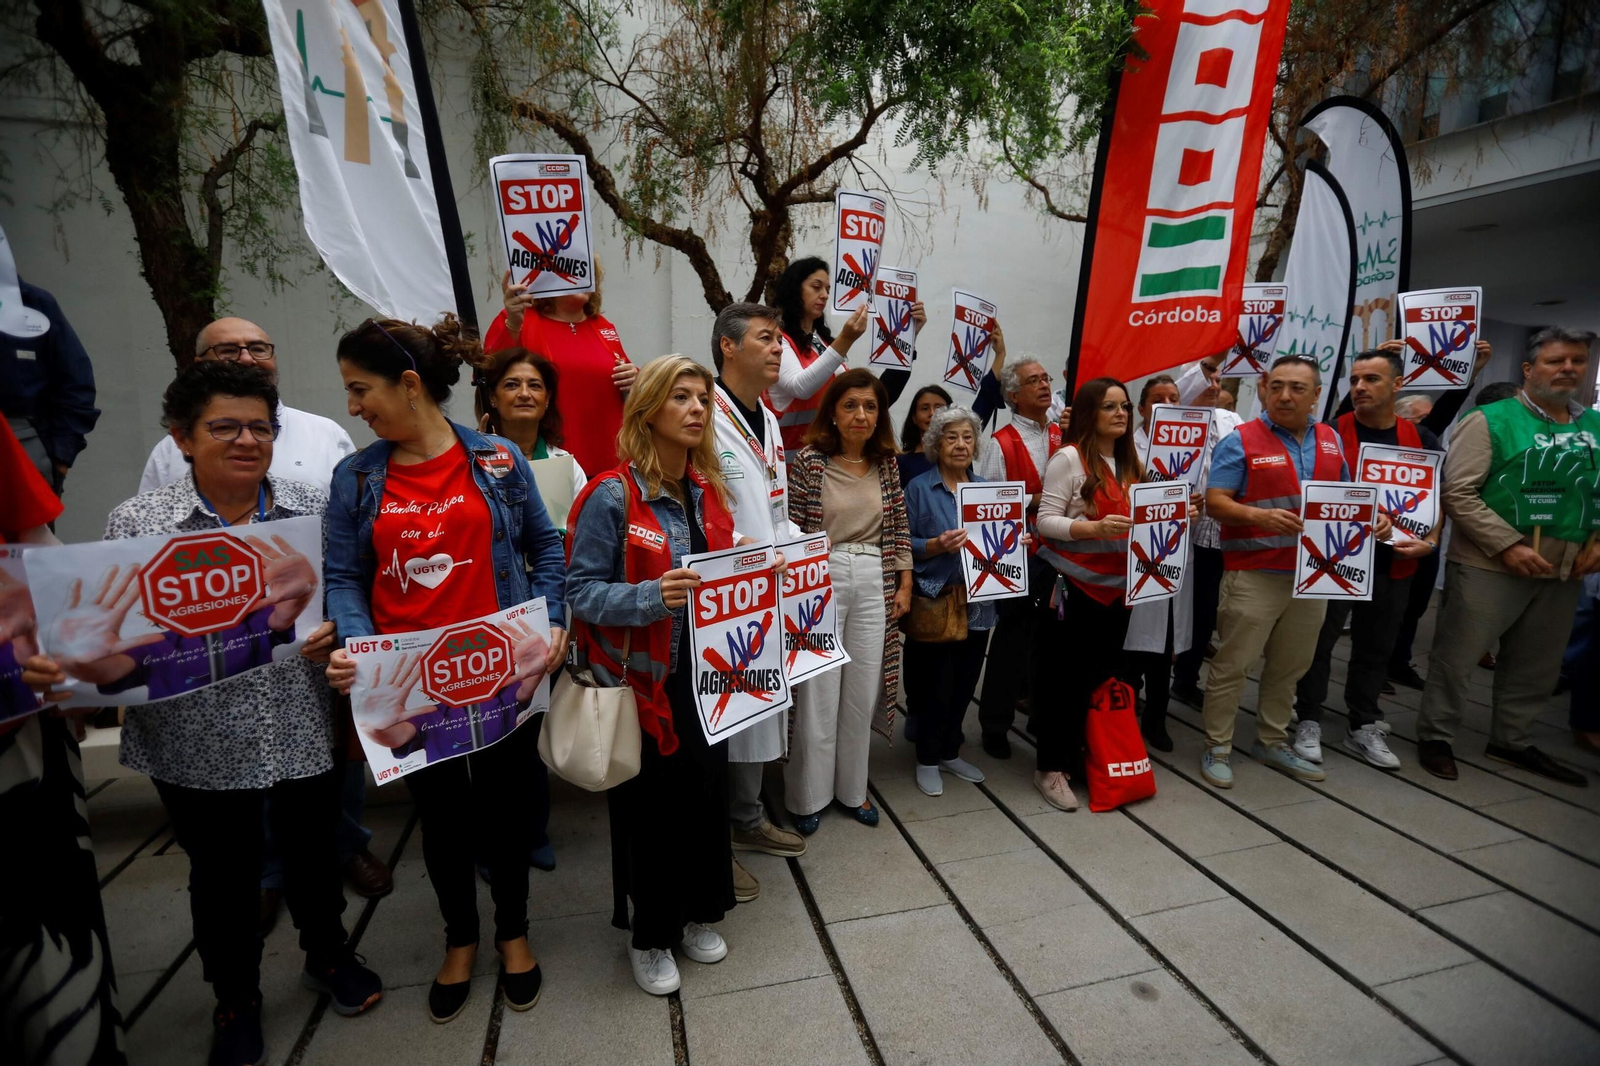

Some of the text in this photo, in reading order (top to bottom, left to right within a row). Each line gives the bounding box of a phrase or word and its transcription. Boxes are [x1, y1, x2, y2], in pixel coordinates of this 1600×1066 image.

[508, 184, 574, 210] STOP
[535, 219, 572, 255] NO
[845, 213, 884, 240] STOP
[511, 249, 587, 277] AGRESIONES
[883, 282, 909, 298] STOP
[888, 299, 911, 335] NO
[964, 309, 988, 327] STOP
[1129, 305, 1221, 327] Córdoba
[1244, 301, 1275, 313] STOP
[1420, 307, 1462, 320] STOP
[964, 325, 988, 358] NO
[1248, 314, 1277, 347] NO
[1428, 320, 1470, 357] NO
[1158, 424, 1202, 444] STOP
[1169, 451, 1193, 477] NO
[1252, 456, 1279, 465] CCOO
[1367, 463, 1426, 485] STOP
[976, 503, 1011, 520] STOP
[1145, 503, 1177, 521] STOP
[1320, 504, 1360, 519] STOP
[1386, 489, 1418, 514] NO
[401, 529, 421, 539] con
[981, 519, 1018, 561] NO
[1150, 520, 1181, 562] NO
[1325, 521, 1364, 561] NO
[174, 546, 230, 571] SAS
[413, 565, 437, 575] UGT
[742, 555, 760, 564] CCOO
[157, 564, 251, 606] STOP
[782, 559, 829, 594] STOP
[167, 594, 249, 618] AGRESIONES
[699, 577, 768, 621] STOP
[506, 609, 520, 620] UGT
[798, 595, 825, 637] NO
[350, 641, 378, 654] UGT
[446, 632, 487, 655] SAS
[726, 621, 764, 674] NO
[785, 632, 835, 651] GRESIONES
[433, 646, 504, 684] STOP
[440, 672, 501, 694] AGRESIONES
[699, 668, 781, 695] AGRESIONES
[376, 768, 392, 780] UGT
[1107, 757, 1151, 777] CCOO
